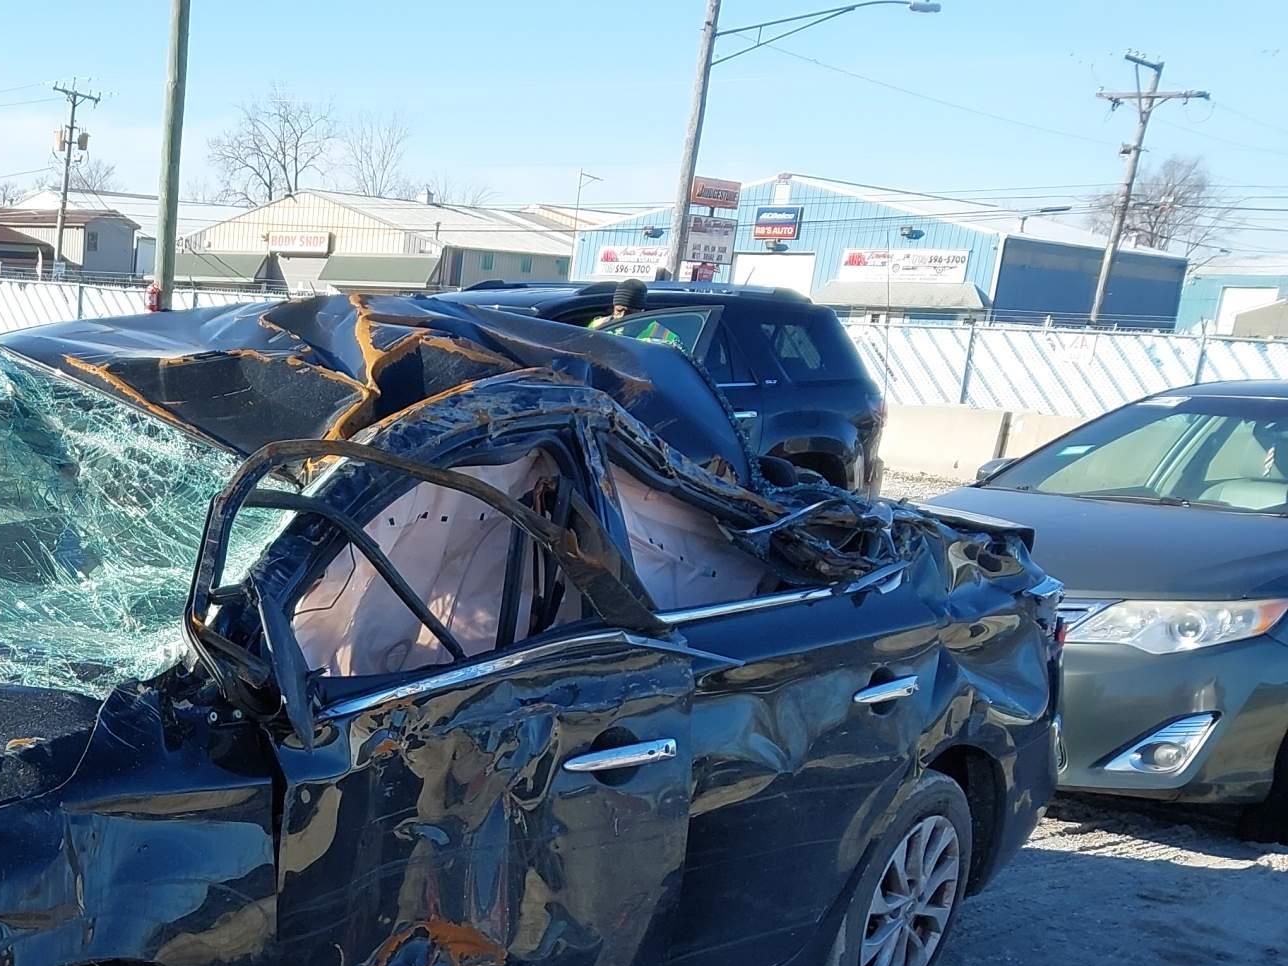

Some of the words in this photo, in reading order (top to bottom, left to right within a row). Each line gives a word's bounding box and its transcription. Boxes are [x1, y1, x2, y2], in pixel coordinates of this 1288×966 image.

[772, 227, 793, 235] AUTO
[271, 235, 296, 247] BODY
[299, 235, 325, 248] SHOP
[927, 255, 966, 265] 596-5700
[614, 264, 651, 274] 596-5700
